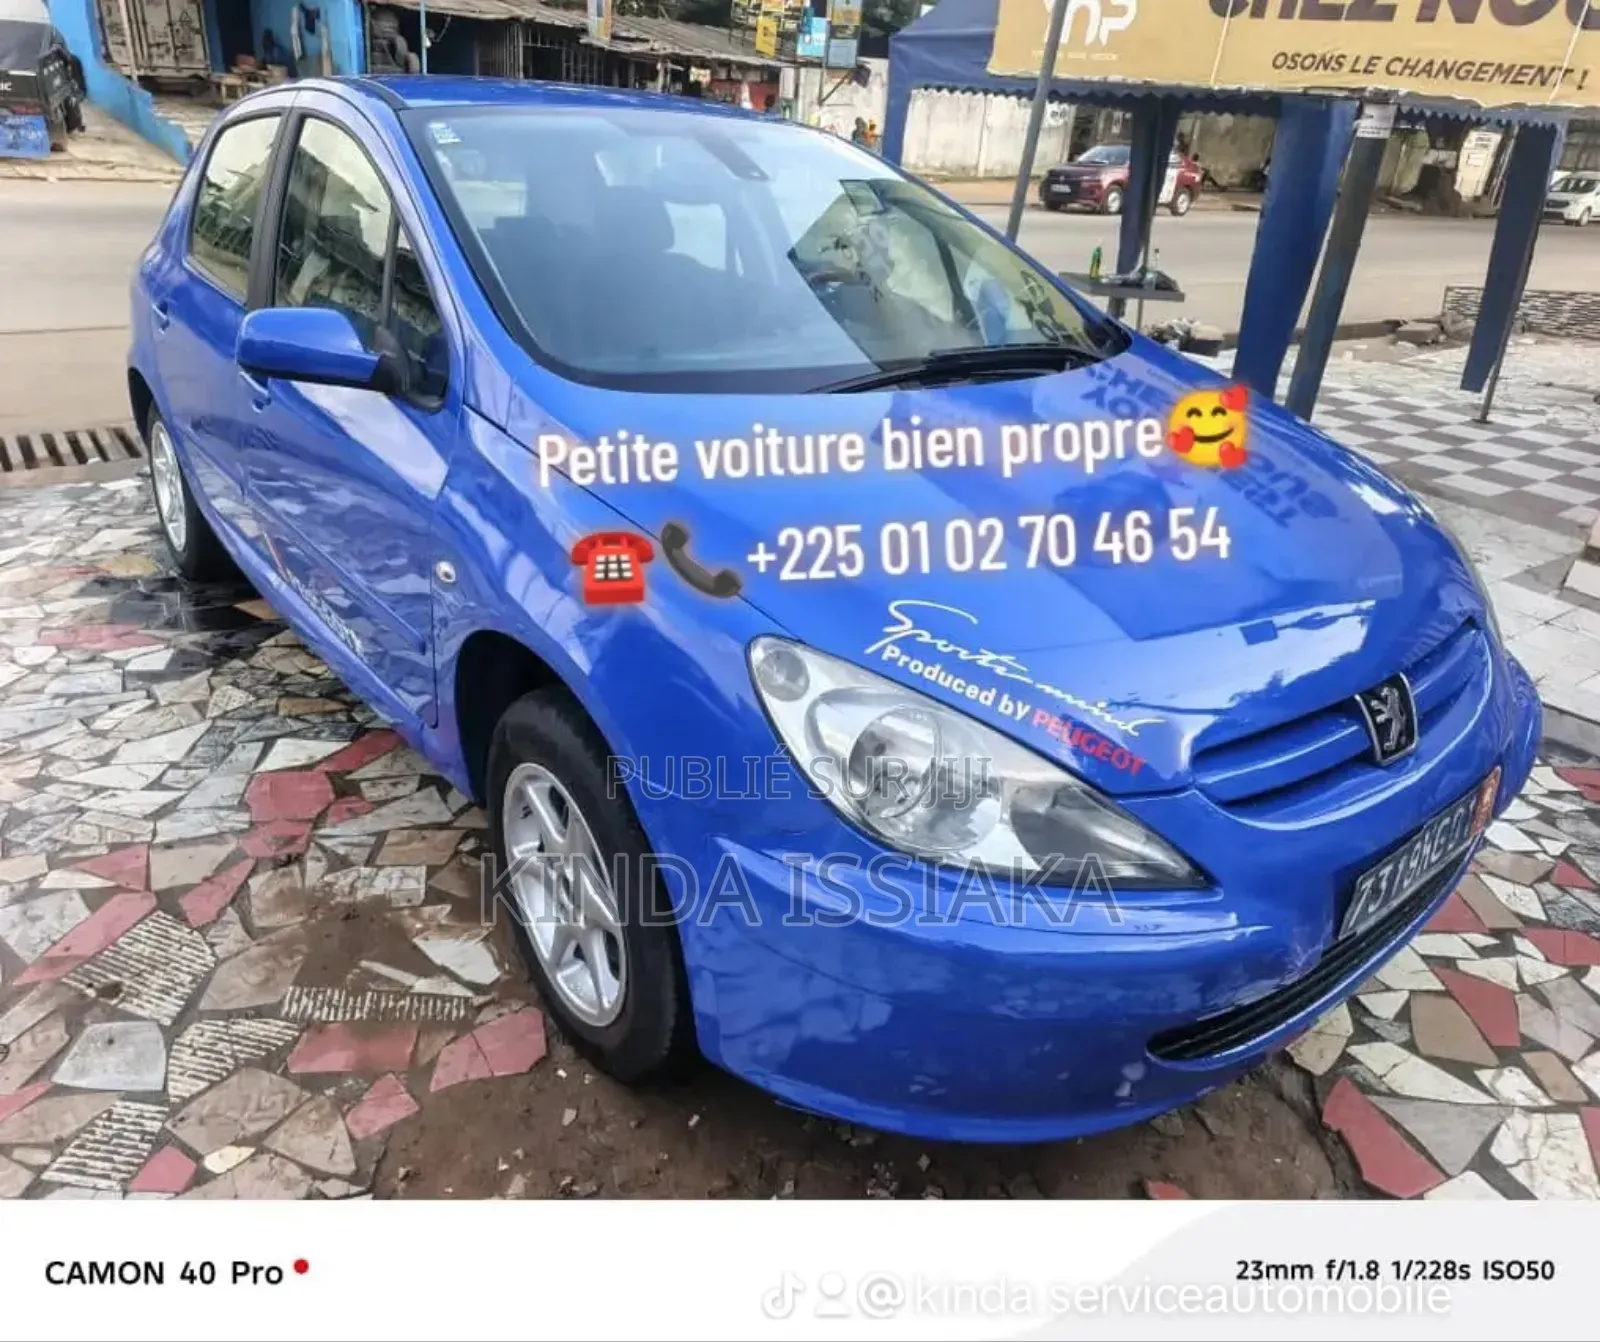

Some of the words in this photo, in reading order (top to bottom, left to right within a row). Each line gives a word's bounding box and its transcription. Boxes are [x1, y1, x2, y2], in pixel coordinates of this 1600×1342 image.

[1272, 51, 1347, 72] OSONS
[1349, 55, 1381, 75] LE
[1385, 56, 1574, 88] CHANGEMENT
[881, 644, 997, 707] Produced
[997, 693, 1031, 722] by
[1031, 707, 1147, 777] PEUGEOT
